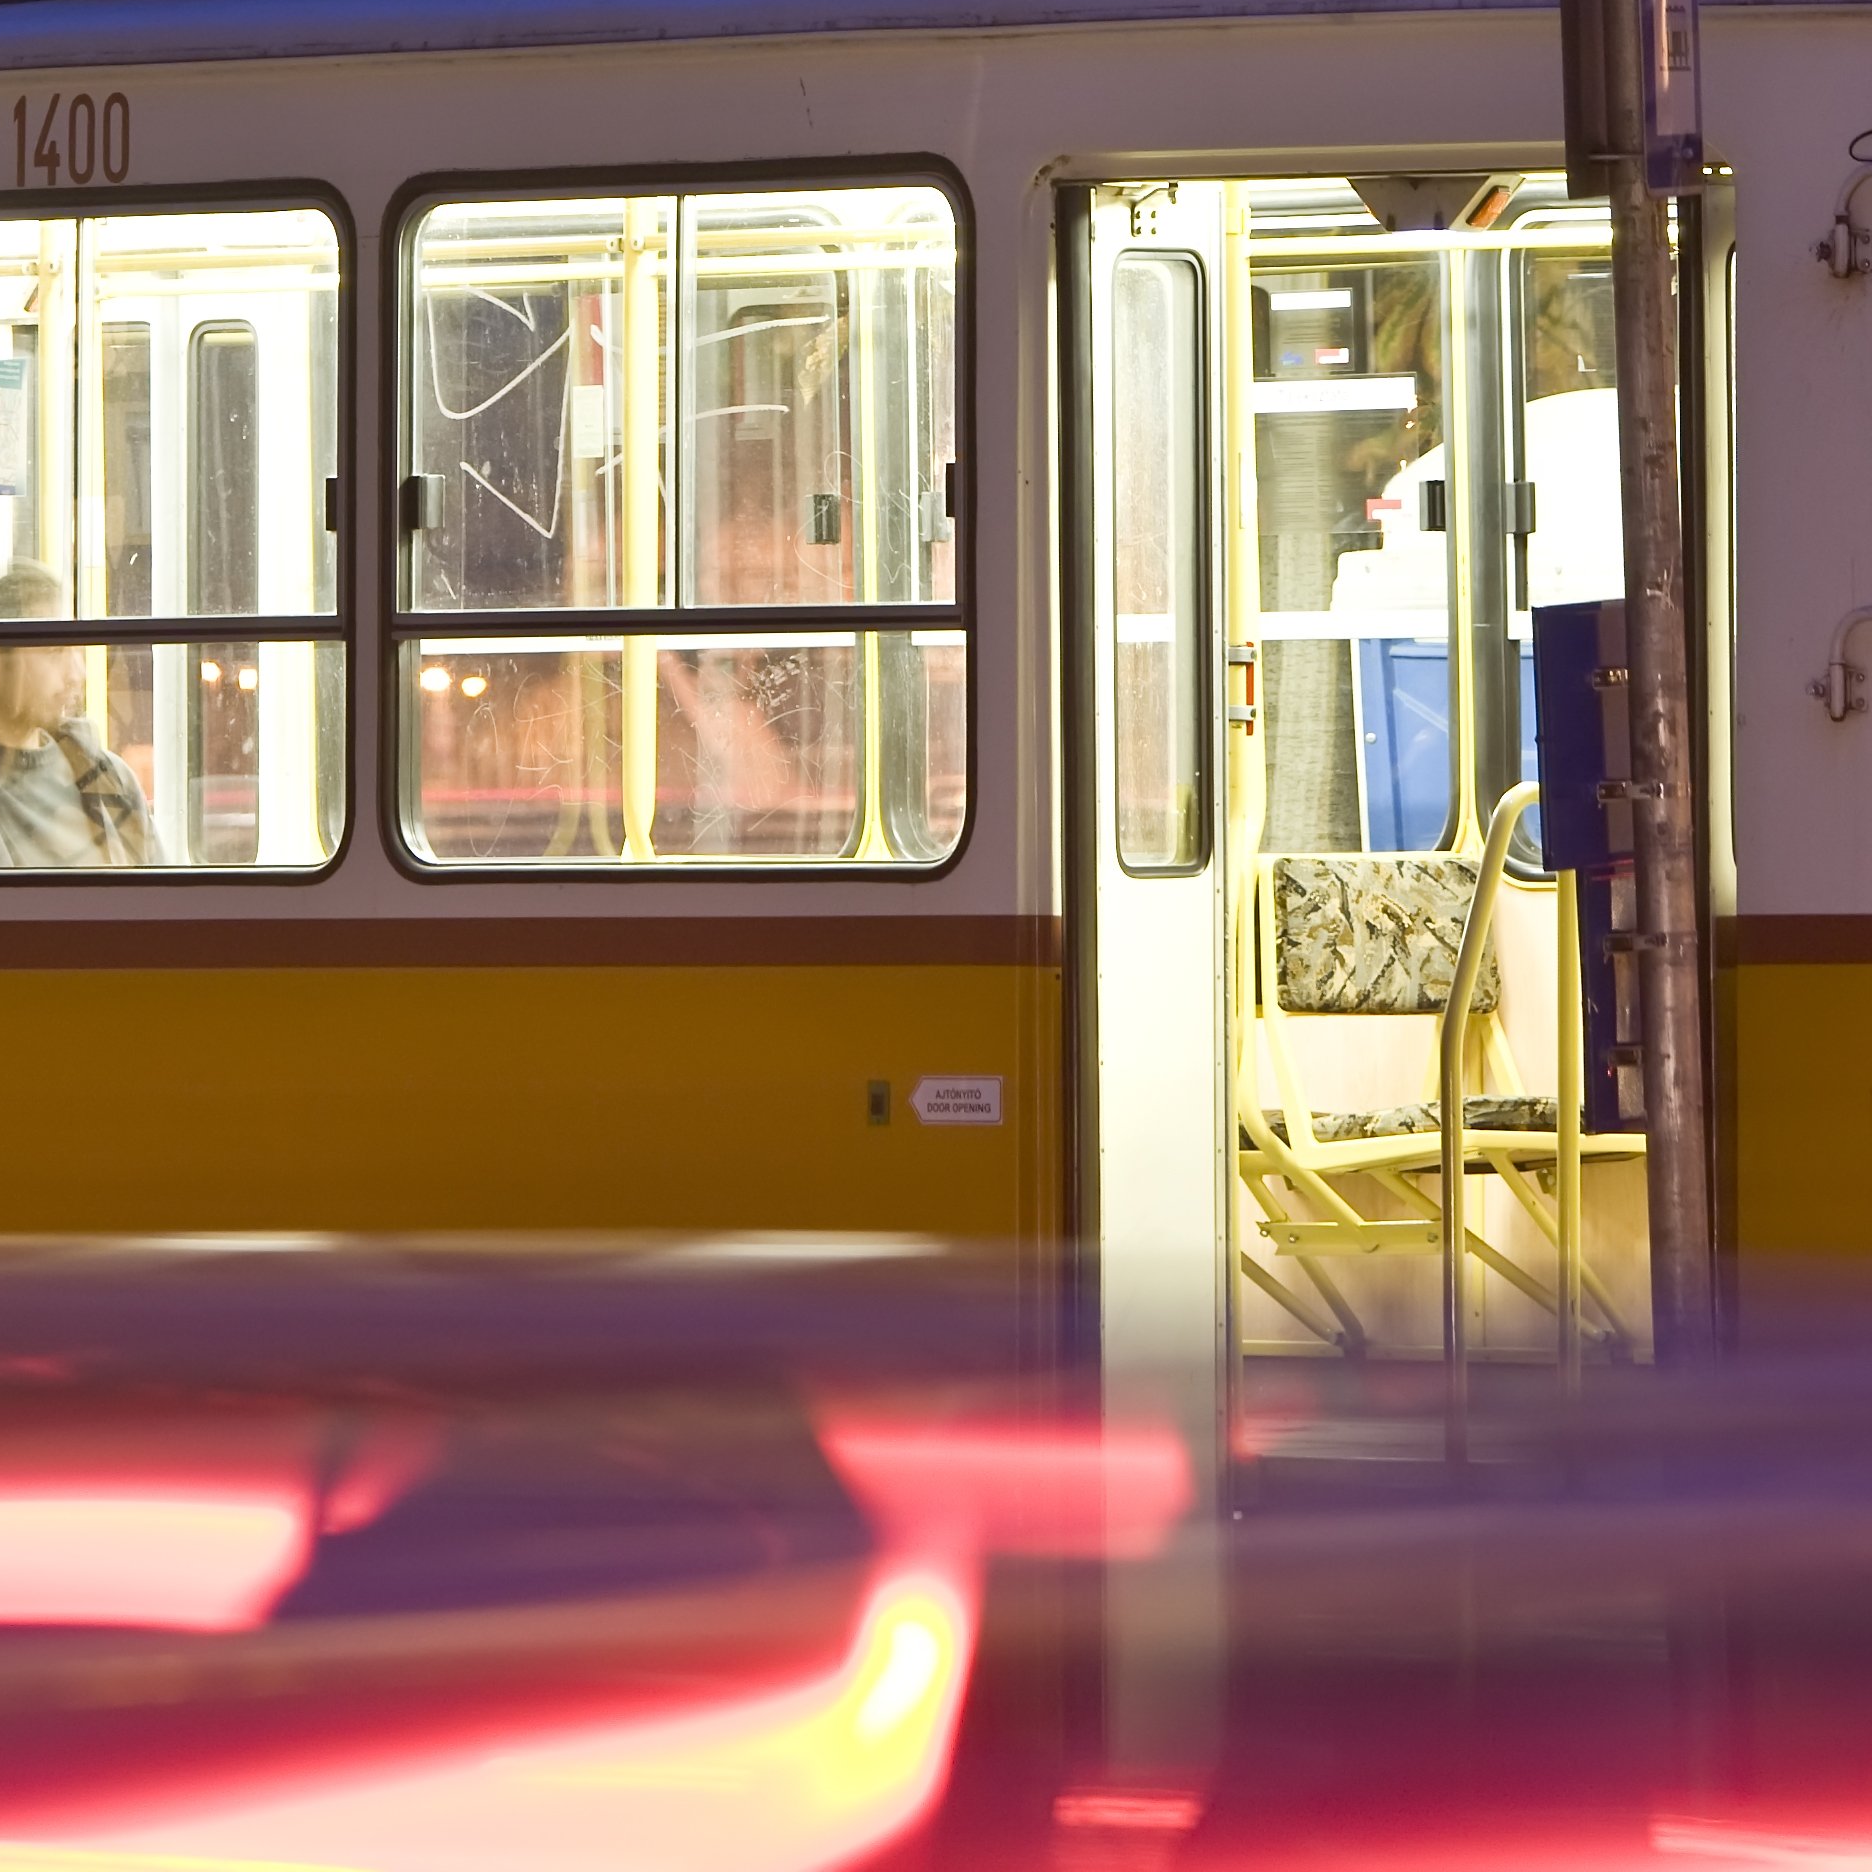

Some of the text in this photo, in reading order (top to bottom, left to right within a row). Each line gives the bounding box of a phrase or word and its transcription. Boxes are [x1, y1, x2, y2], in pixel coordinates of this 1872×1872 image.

[13, 91, 130, 188] 1400
[935, 1088, 982, 1101] AJTÓNYITÓ
[927, 1102, 992, 1114] DOOR OPENING
